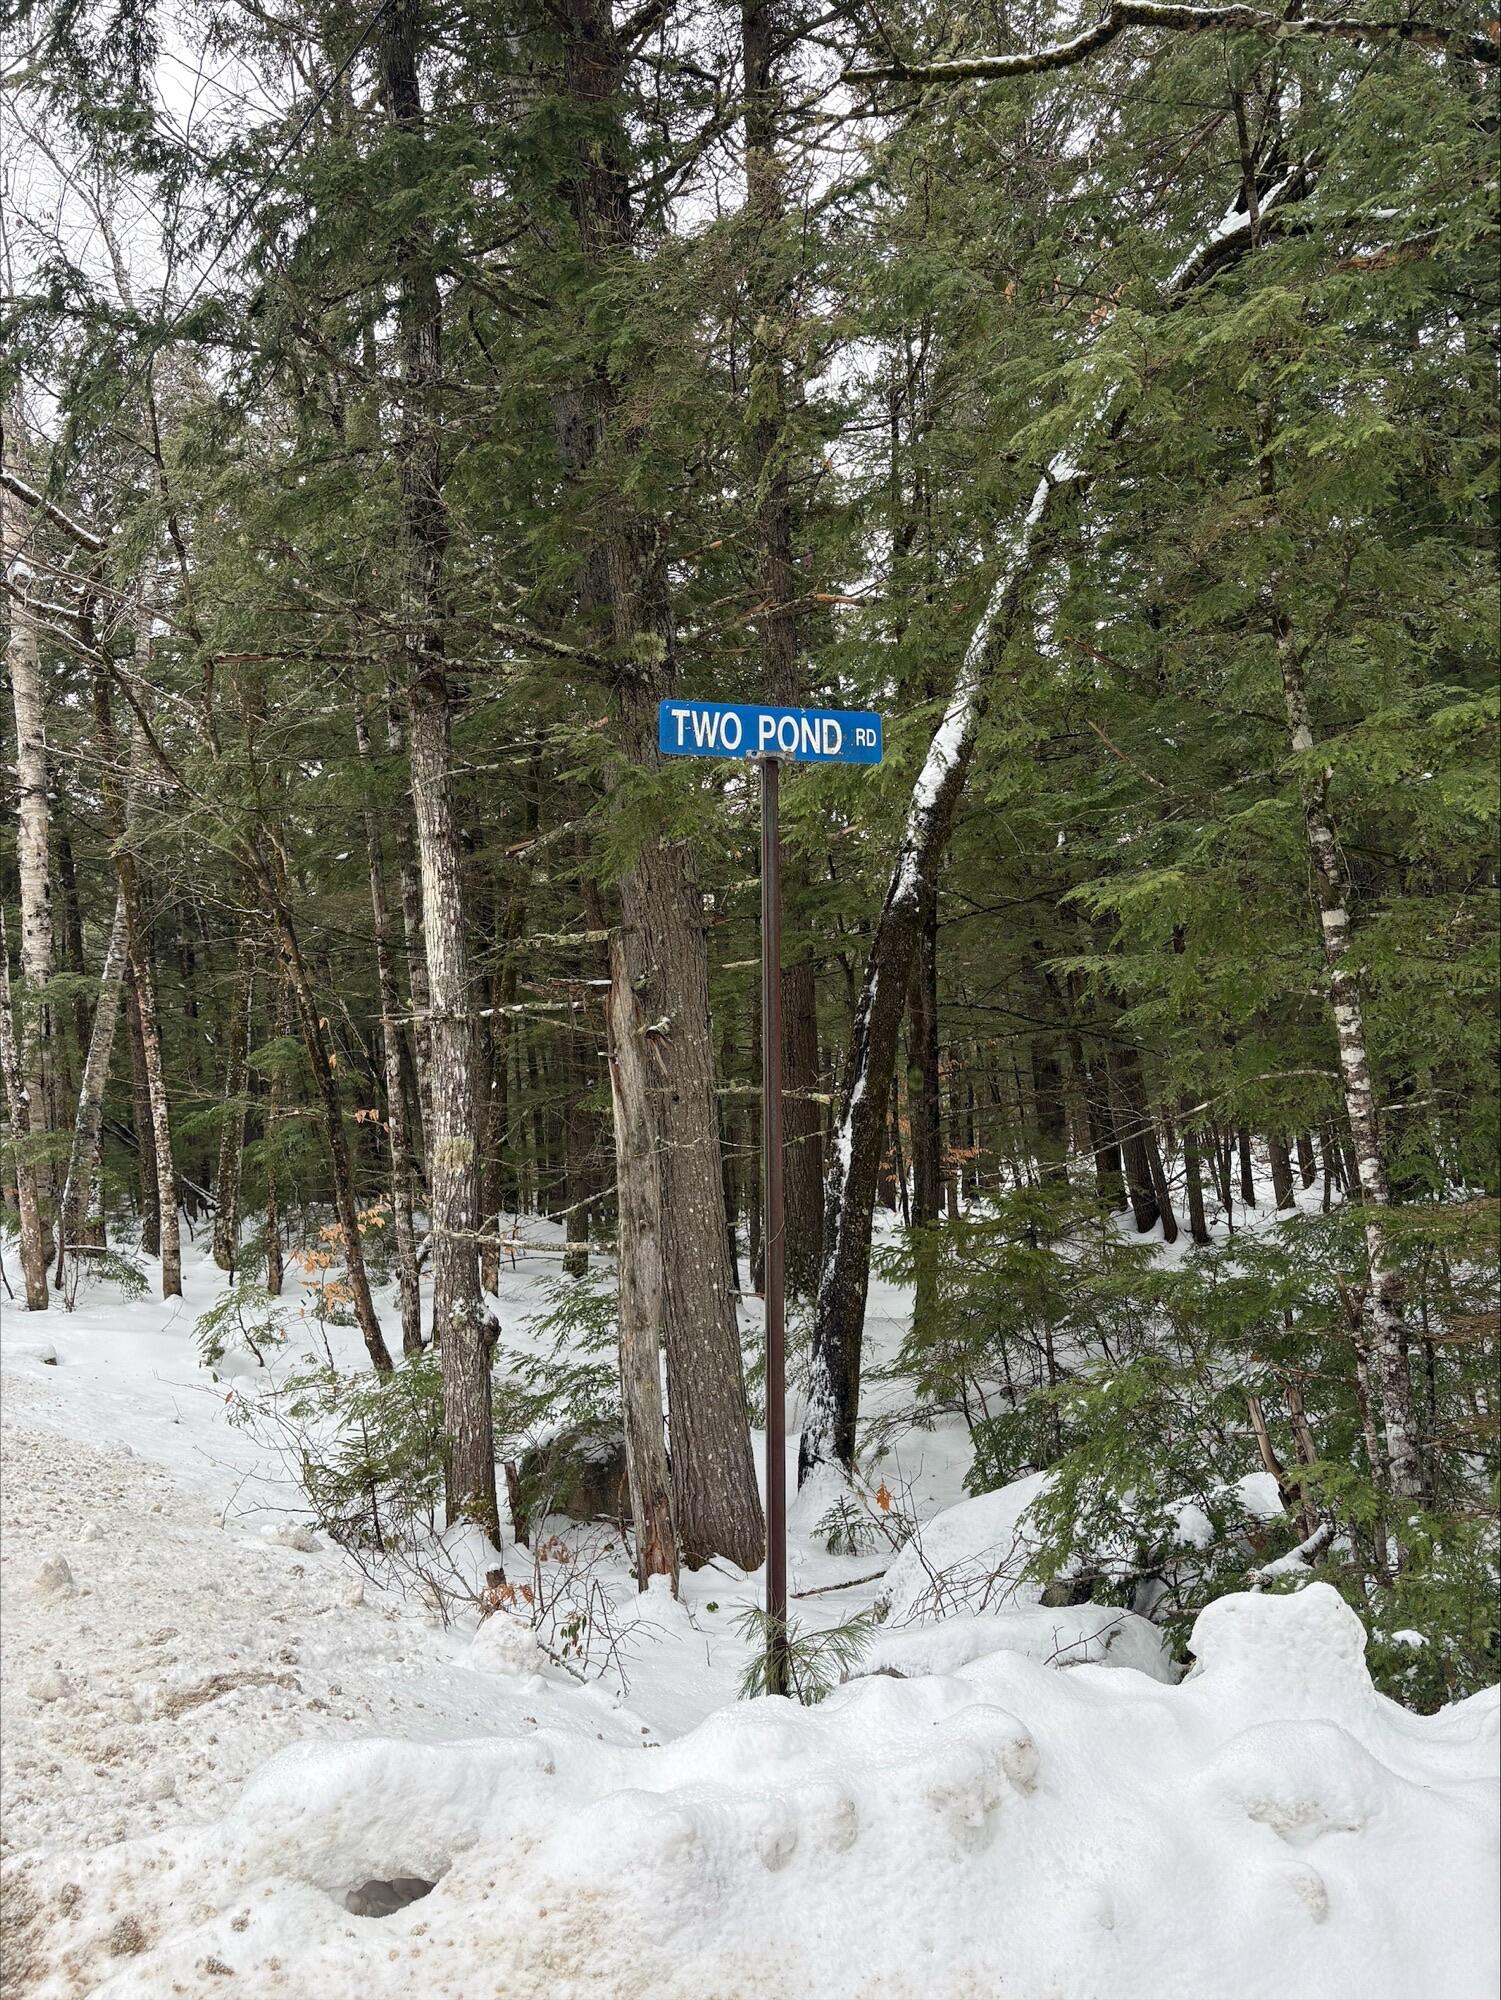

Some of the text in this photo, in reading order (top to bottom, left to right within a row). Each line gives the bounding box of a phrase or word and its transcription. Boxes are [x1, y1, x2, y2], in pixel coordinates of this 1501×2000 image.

[671, 709, 877, 755] TWO POND RD
